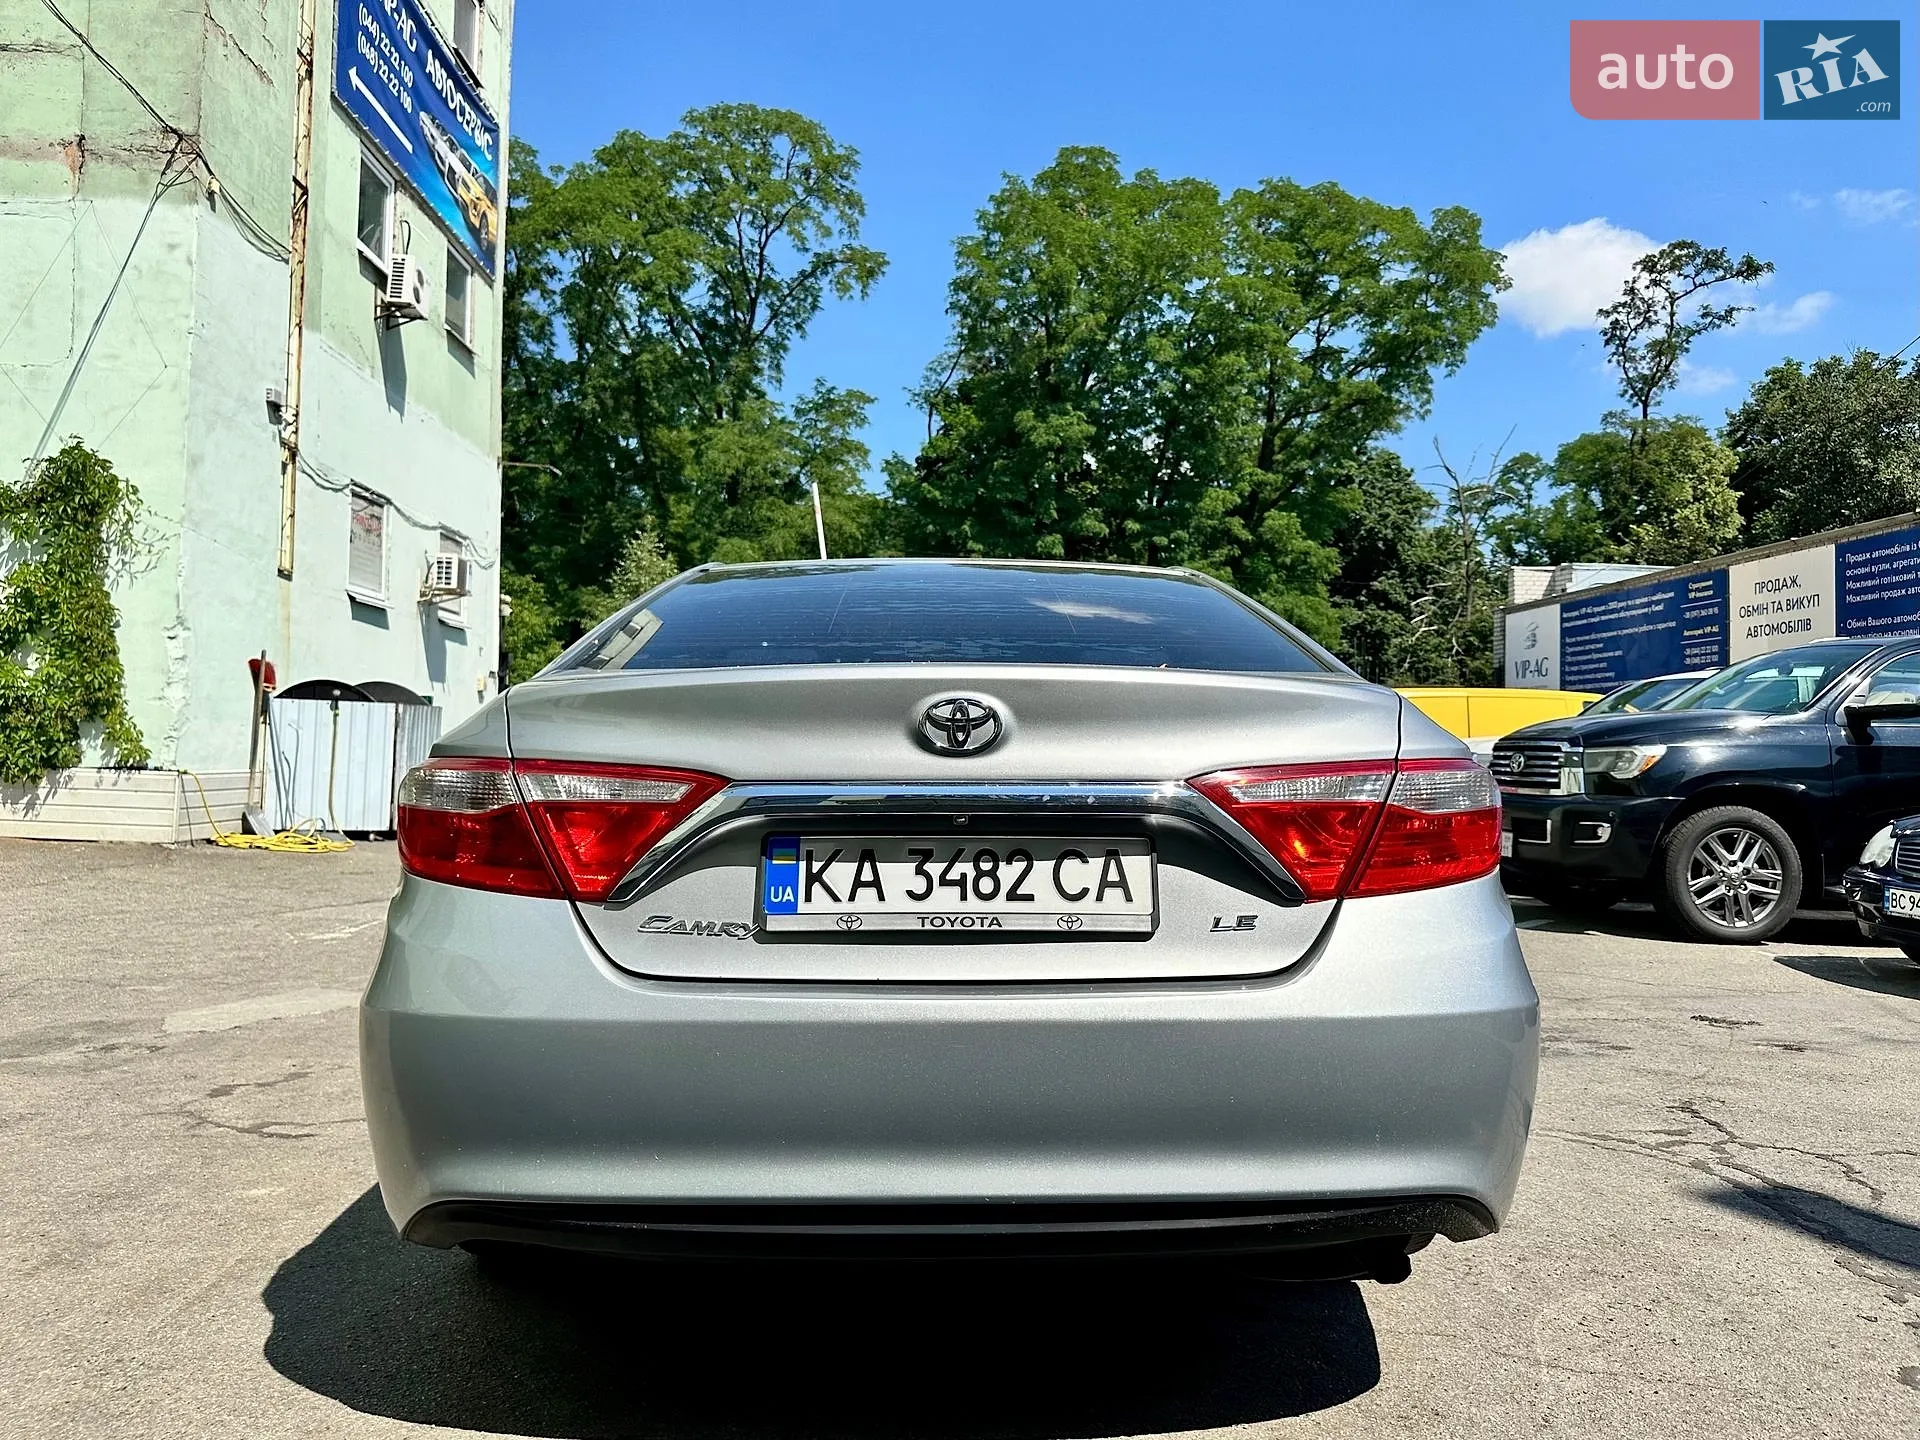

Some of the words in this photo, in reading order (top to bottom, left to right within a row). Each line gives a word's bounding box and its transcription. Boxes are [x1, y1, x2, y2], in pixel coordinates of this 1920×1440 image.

[359, 2, 380, 46] (044)
[380, 32, 390, 57] 22
[390, 46, 400, 70] 22
[400, 60, 414, 88] 100
[358, 30, 378, 73] (068)
[379, 59, 389, 84] 22
[389, 73, 398, 96] 22
[400, 86, 412, 114] 100
[425, 48, 493, 161] АВТОСЕРВІС
[1846, 553, 1870, 564] Продаж
[1872, 544, 1910, 558] автомобілів
[1846, 564, 1870, 576] основні
[1754, 575, 1801, 595] ПРОДАЖ,
[1846, 577, 1880, 590] Можливий
[1880, 571, 1916, 584] готівковий
[1739, 602, 1768, 618] ОБМІН
[1771, 600, 1784, 613] ТА
[1786, 594, 1820, 611] ВИКУП
[1846, 591, 1880, 603] Можливий
[1881, 589, 1906, 600] продаж
[1746, 618, 1812, 639] АВТОМОБІЛІВ
[1846, 619, 1866, 629] Обмін
[1868, 617, 1892, 626] Вашого
[1515, 657, 1549, 680] VIP-AG
[770, 886, 795, 902] UA
[804, 848, 886, 902] KA
[905, 847, 1035, 902] 3482
[1052, 847, 1133, 903] CA
[1891, 892, 1906, 910] BC
[638, 915, 760, 940] CAMRY
[917, 916, 1003, 928] TOYOTA
[1210, 914, 1259, 932] LE
